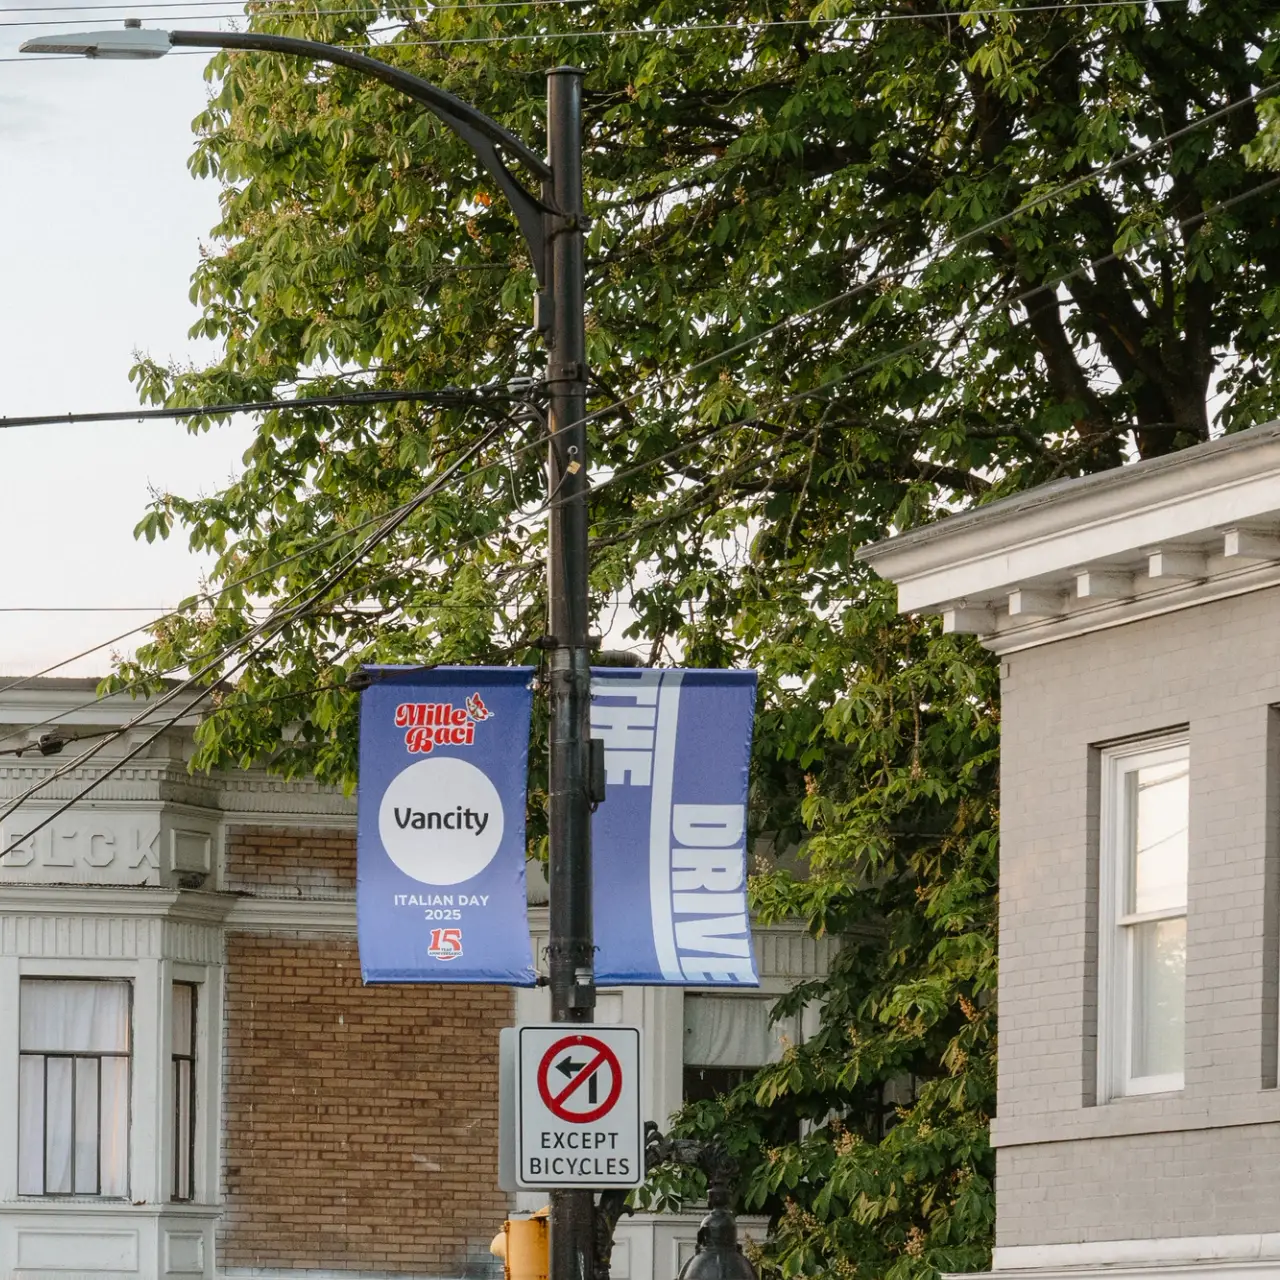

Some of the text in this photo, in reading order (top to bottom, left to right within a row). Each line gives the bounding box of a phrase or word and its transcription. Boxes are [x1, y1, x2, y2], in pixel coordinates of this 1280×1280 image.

[394, 703, 467, 728] Mille
[405, 721, 476, 754] Baci
[394, 806, 489, 836] Vancity
[394, 894, 489, 906] ITALIAN DAY
[424, 909, 461, 920] 2025
[429, 928, 462, 952] 15
[541, 1132, 619, 1149] EXCEPT
[530, 1157, 630, 1175] BICYCLES
